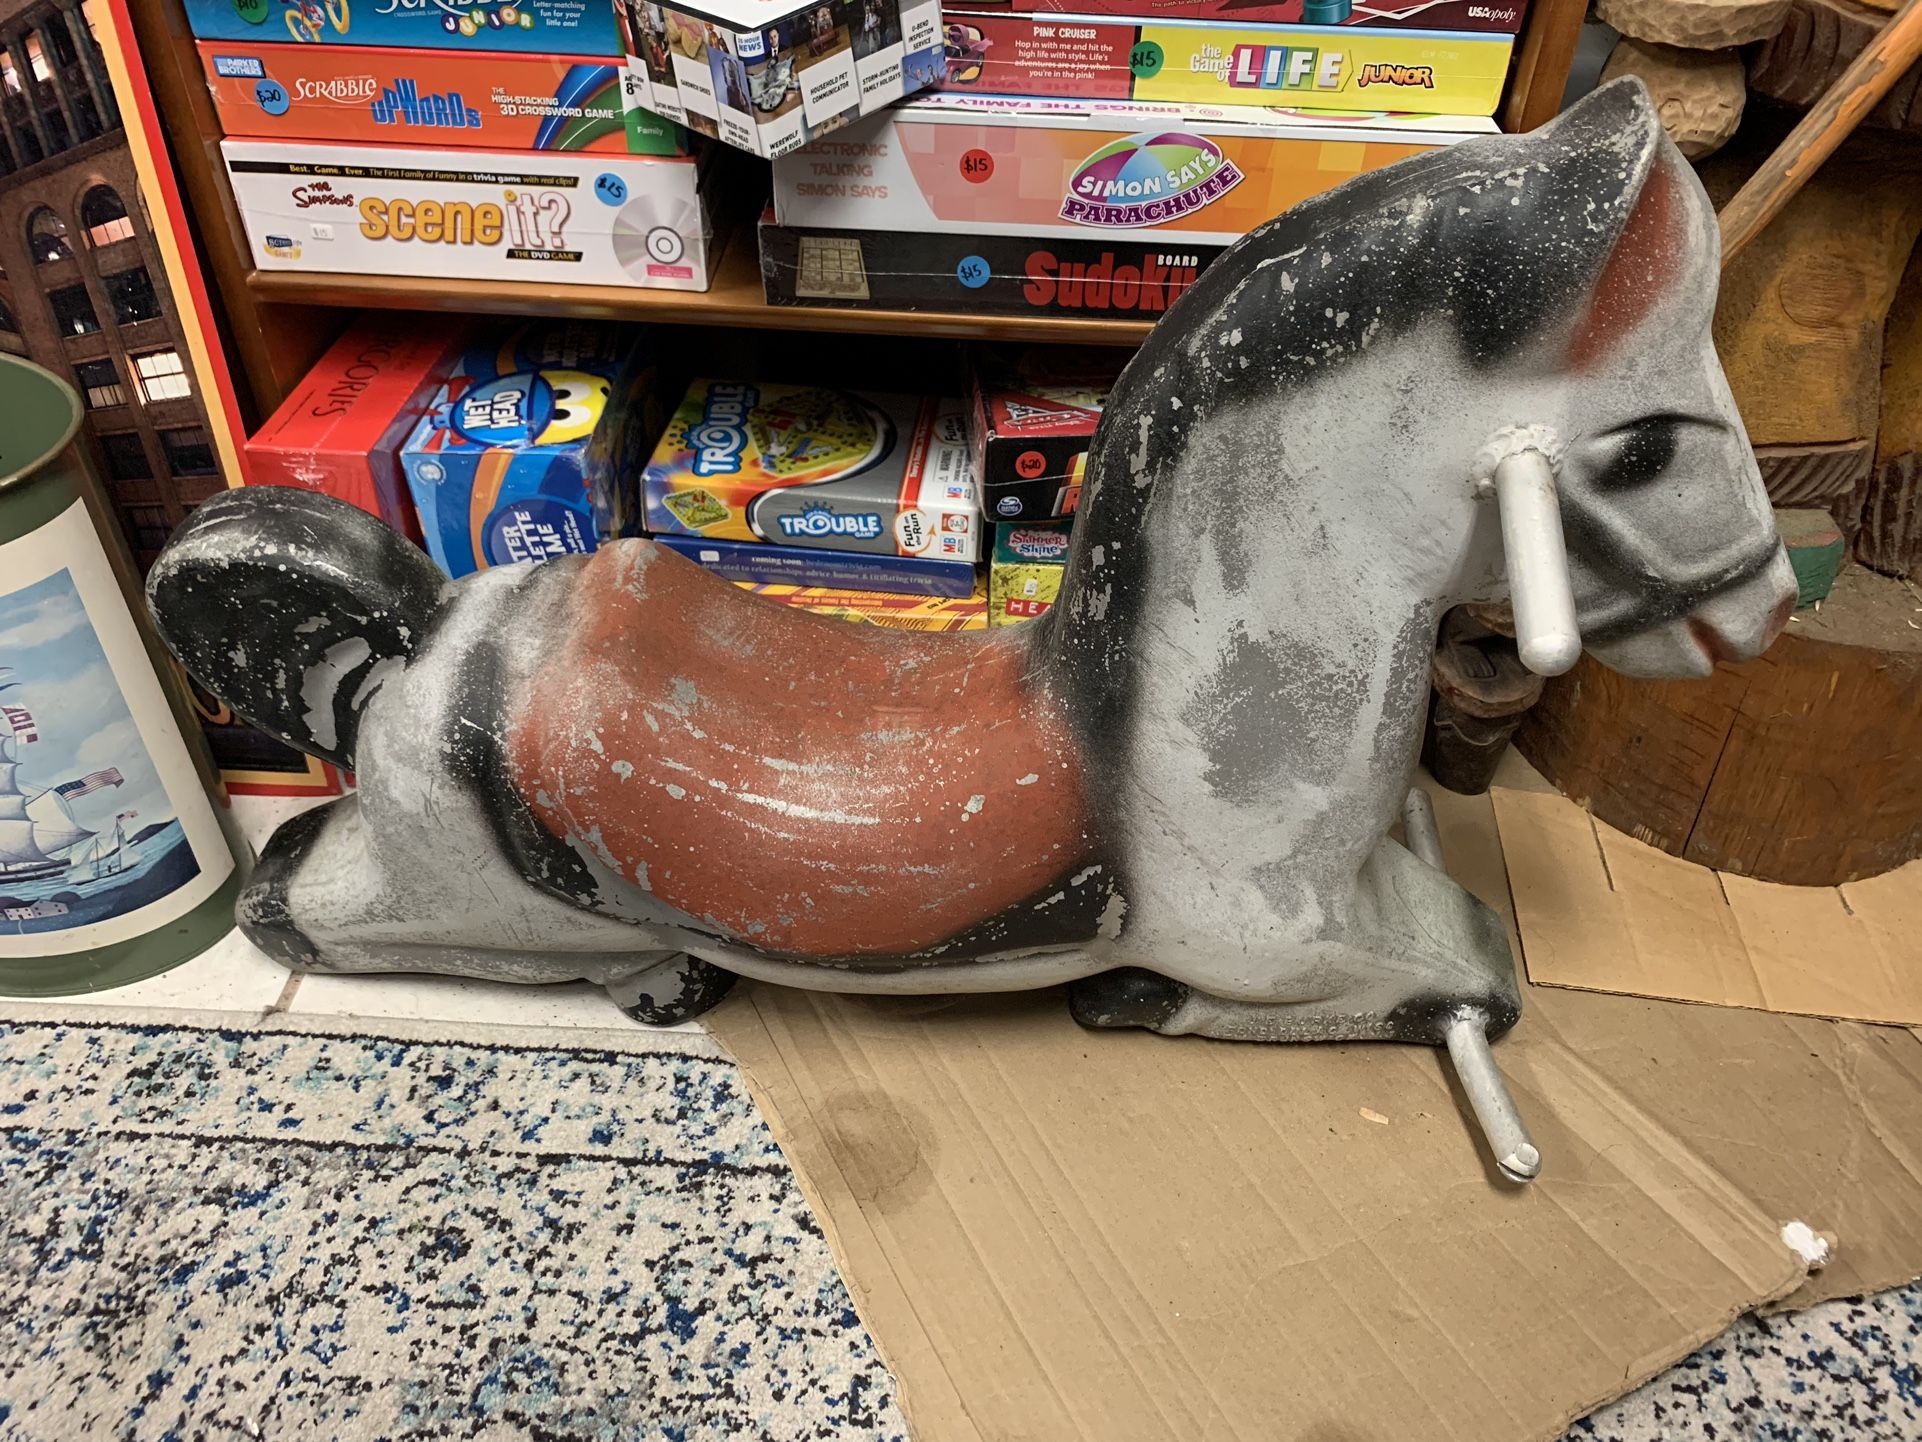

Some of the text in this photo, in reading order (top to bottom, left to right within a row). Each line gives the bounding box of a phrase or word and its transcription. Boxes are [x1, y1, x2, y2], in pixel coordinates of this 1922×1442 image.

[533, 1, 586, 11] Letter-matching
[444, 7, 532, 35] JUNIOR
[540, 10, 581, 20] fun for your
[911, 19, 929, 32] U-BEND
[1033, 26, 1096, 40] PINK CRUISER
[908, 26, 934, 43] INSPECTION
[738, 42, 762, 52] NEWS
[913, 37, 932, 50] SERVICE
[1015, 40, 1031, 50] Hop
[1032, 40, 1040, 49] in
[1041, 41, 1058, 50] with
[1073, 43, 1087, 51] and
[1089, 43, 1099, 52] hit
[1101, 44, 1113, 52] the
[1202, 43, 1222, 59] the
[227, 58, 259, 67] PARKER
[1018, 50, 1108, 62] high life with style. Life's
[1130, 49, 1157, 70] $15
[219, 66, 262, 75] BROTHERS
[1015, 60, 1056, 68] adventures
[1091, 63, 1110, 71] when
[1190, 53, 1233, 82] Game of
[1235, 48, 1344, 87] LIFE
[810, 71, 849, 95] HOUSEHOLD PET
[862, 63, 899, 86] STORM-HUNTING
[1029, 70, 1052, 79] you're
[1061, 70, 1075, 78] the
[1076, 71, 1095, 80] pink!
[1357, 63, 1435, 88] JUNIOR
[491, 87, 505, 95] THE
[863, 72, 902, 95] FAMILY HOLIDAYS
[256, 88, 281, 108] $20
[491, 94, 559, 106] HIGH-STACKING
[812, 81, 850, 105] COMMUNICATOR
[500, 104, 615, 119] 3D CROSSWORD GAME
[955, 98, 1032, 108] FAMILY
[1040, 102, 1085, 110] THE
[1094, 103, 1182, 113] BRINGS
[637, 126, 664, 136] Family
[769, 130, 799, 150] WEREWOLF
[770, 138, 802, 159] FLOOR RUGS
[811, 162, 873, 178] TALKING
[963, 156, 989, 174] $15
[1076, 148, 1217, 198] SIMON SAYS
[289, 164, 310, 173] Best.
[314, 166, 341, 175] Game.
[345, 167, 365, 176] Ever.
[369, 168, 383, 177] The
[384, 169, 399, 178] First
[401, 170, 424, 180] Family
[425, 171, 433, 179] of
[434, 171, 457, 181] Funny
[473, 173, 496, 183] trivia
[498, 175, 521, 185] game
[523, 176, 539, 184] with
[540, 177, 554, 185] real
[555, 177, 574, 187] clips!
[597, 176, 624, 198] $15
[796, 182, 888, 199] SIMON SAYS
[1062, 165, 1239, 226] PARACHUTE
[359, 189, 571, 249] scene it?
[514, 251, 576, 261] THE DVD GAME
[1157, 254, 1199, 267] BOARD
[960, 264, 982, 282] $15
[312, 335, 392, 419] RGORIES
[463, 398, 492, 429] WET
[491, 391, 522, 429] HEAD
[700, 384, 747, 473] TROUBLE
[947, 487, 962, 499] MB
[780, 513, 882, 537] TROUBLE
[912, 513, 921, 533] Run
[513, 511, 548, 563] LETTE
[854, 531, 876, 539] GAME
[904, 522, 913, 547] Fun
[502, 525, 529, 562] TER
[943, 537, 956, 553] MB
[751, 555, 781, 567] coming
[782, 557, 804, 566] soon:
[741, 564, 750, 573] to
[909, 576, 932, 585] trivia
